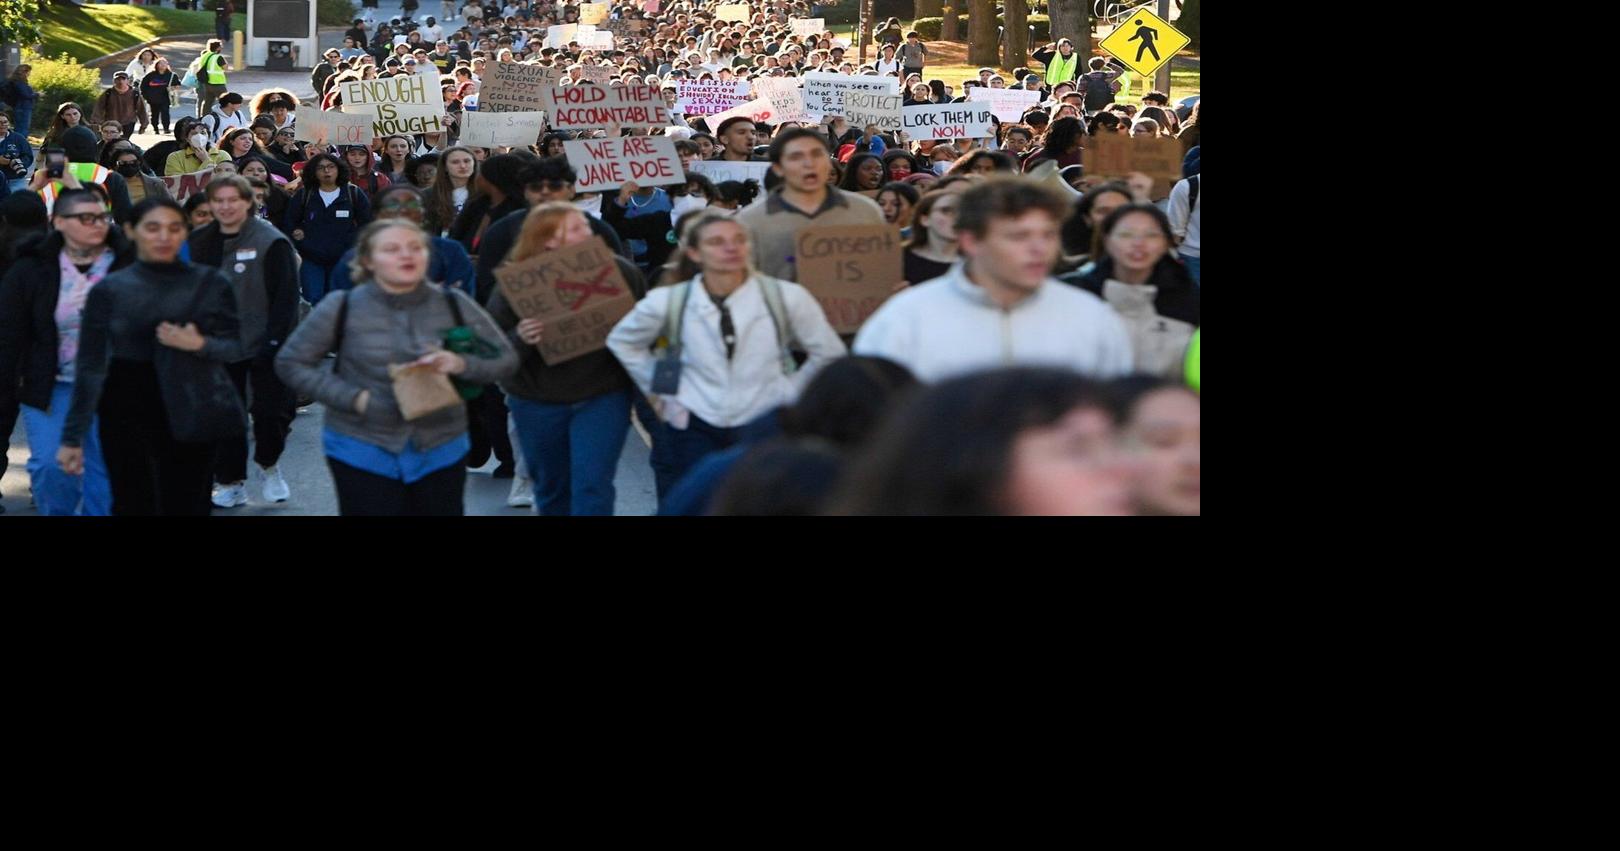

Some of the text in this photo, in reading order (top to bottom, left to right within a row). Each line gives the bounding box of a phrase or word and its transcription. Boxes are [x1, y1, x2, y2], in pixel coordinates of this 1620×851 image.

[497, 62, 555, 79] SEXUAL
[349, 76, 426, 104] ENOUGH
[502, 81, 539, 91] NOT
[552, 86, 663, 105] HOLD THEM
[489, 93, 540, 103] COLLEGE
[806, 103, 819, 111] You
[845, 92, 903, 110] PROTECT
[376, 104, 398, 120] IS
[556, 106, 668, 127] ACCOUNTABLE
[845, 110, 901, 128] SURVIVORS
[904, 110, 992, 127] LOCK THEM UP
[372, 115, 441, 137] NOUGH
[932, 125, 965, 138] NOW
[584, 137, 658, 161] WE ARE
[579, 158, 674, 186] JANE DOE
[799, 230, 894, 259] Consent
[502, 262, 565, 293] BOYS
[834, 260, 864, 282] IS
[516, 294, 553, 318] BE
